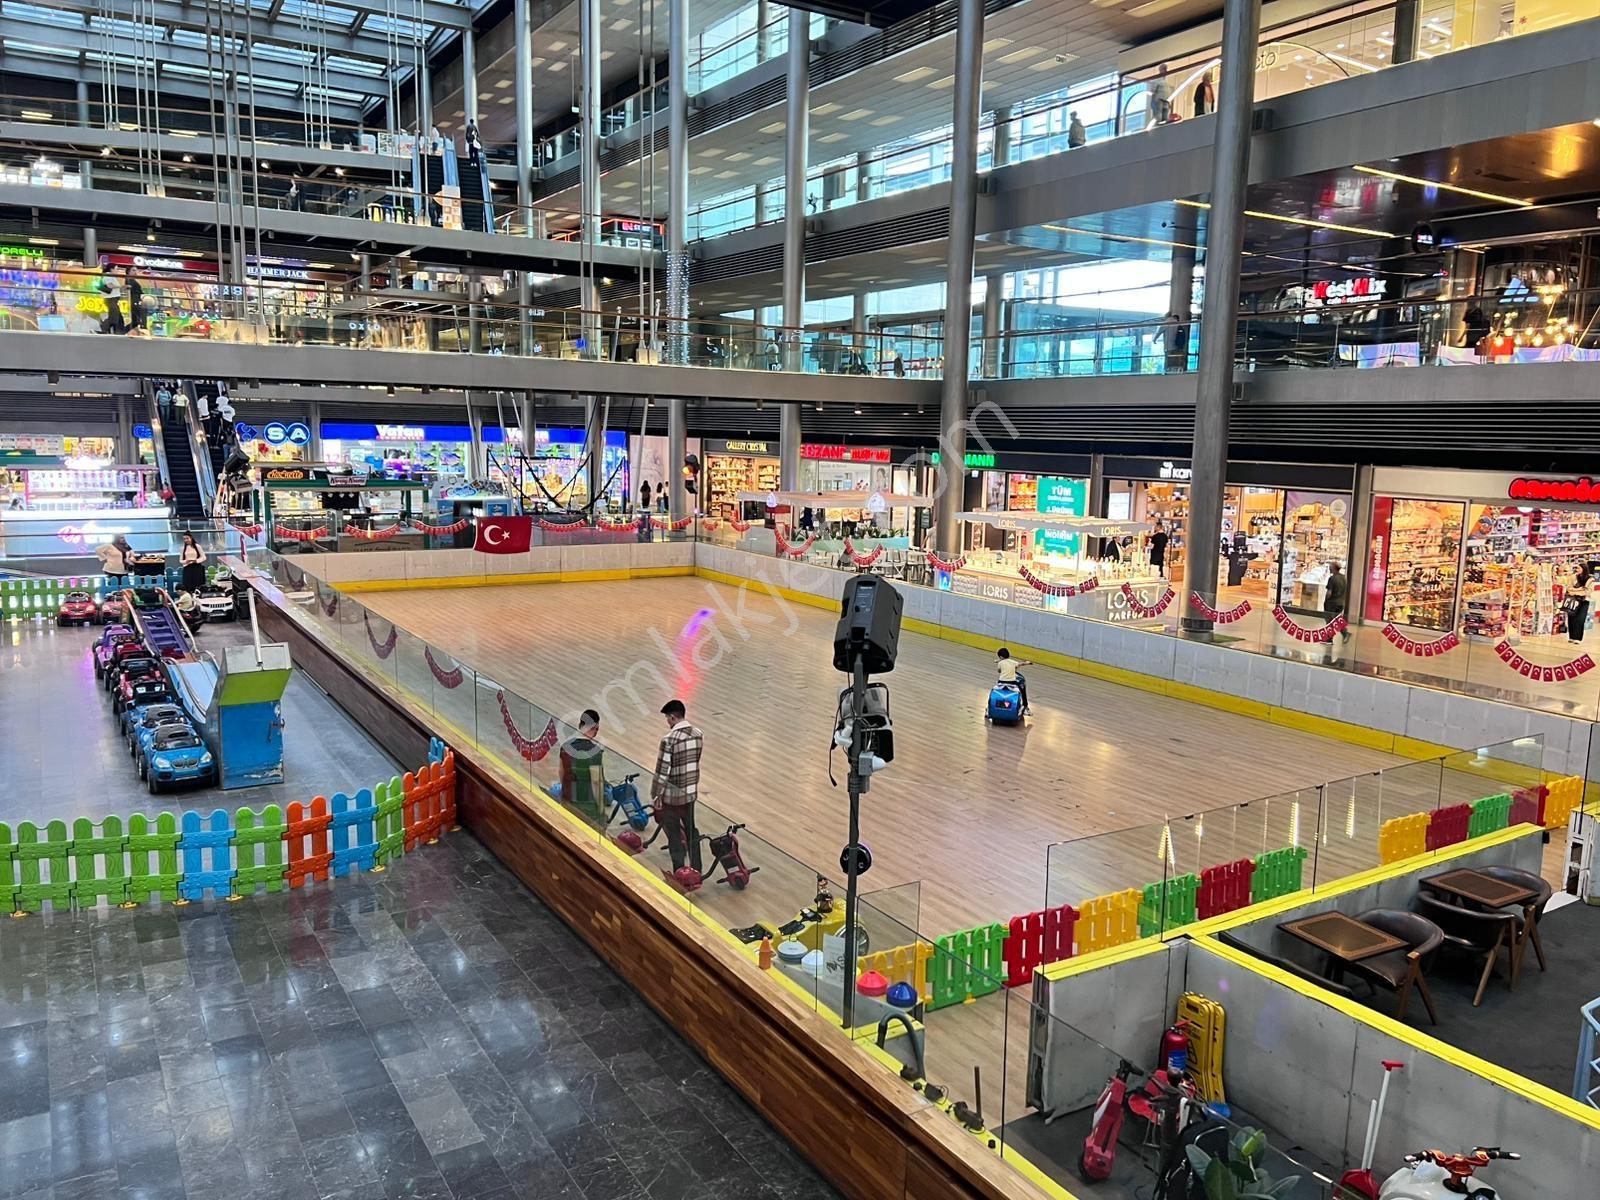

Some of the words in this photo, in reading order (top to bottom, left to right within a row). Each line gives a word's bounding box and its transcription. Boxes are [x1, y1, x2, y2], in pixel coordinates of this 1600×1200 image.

[0, 246, 43, 257] ORELLI
[143, 257, 184, 269] vodafone
[286, 269, 308, 279] JACK
[1313, 277, 1387, 298] WestMix
[931, 451, 995, 467] DMANN
[998, 519, 1016, 529] LORIS
[1101, 526, 1121, 536] LORIS
[983, 584, 1008, 600] LORIS
[1563, 597, 1580, 611] GAP
